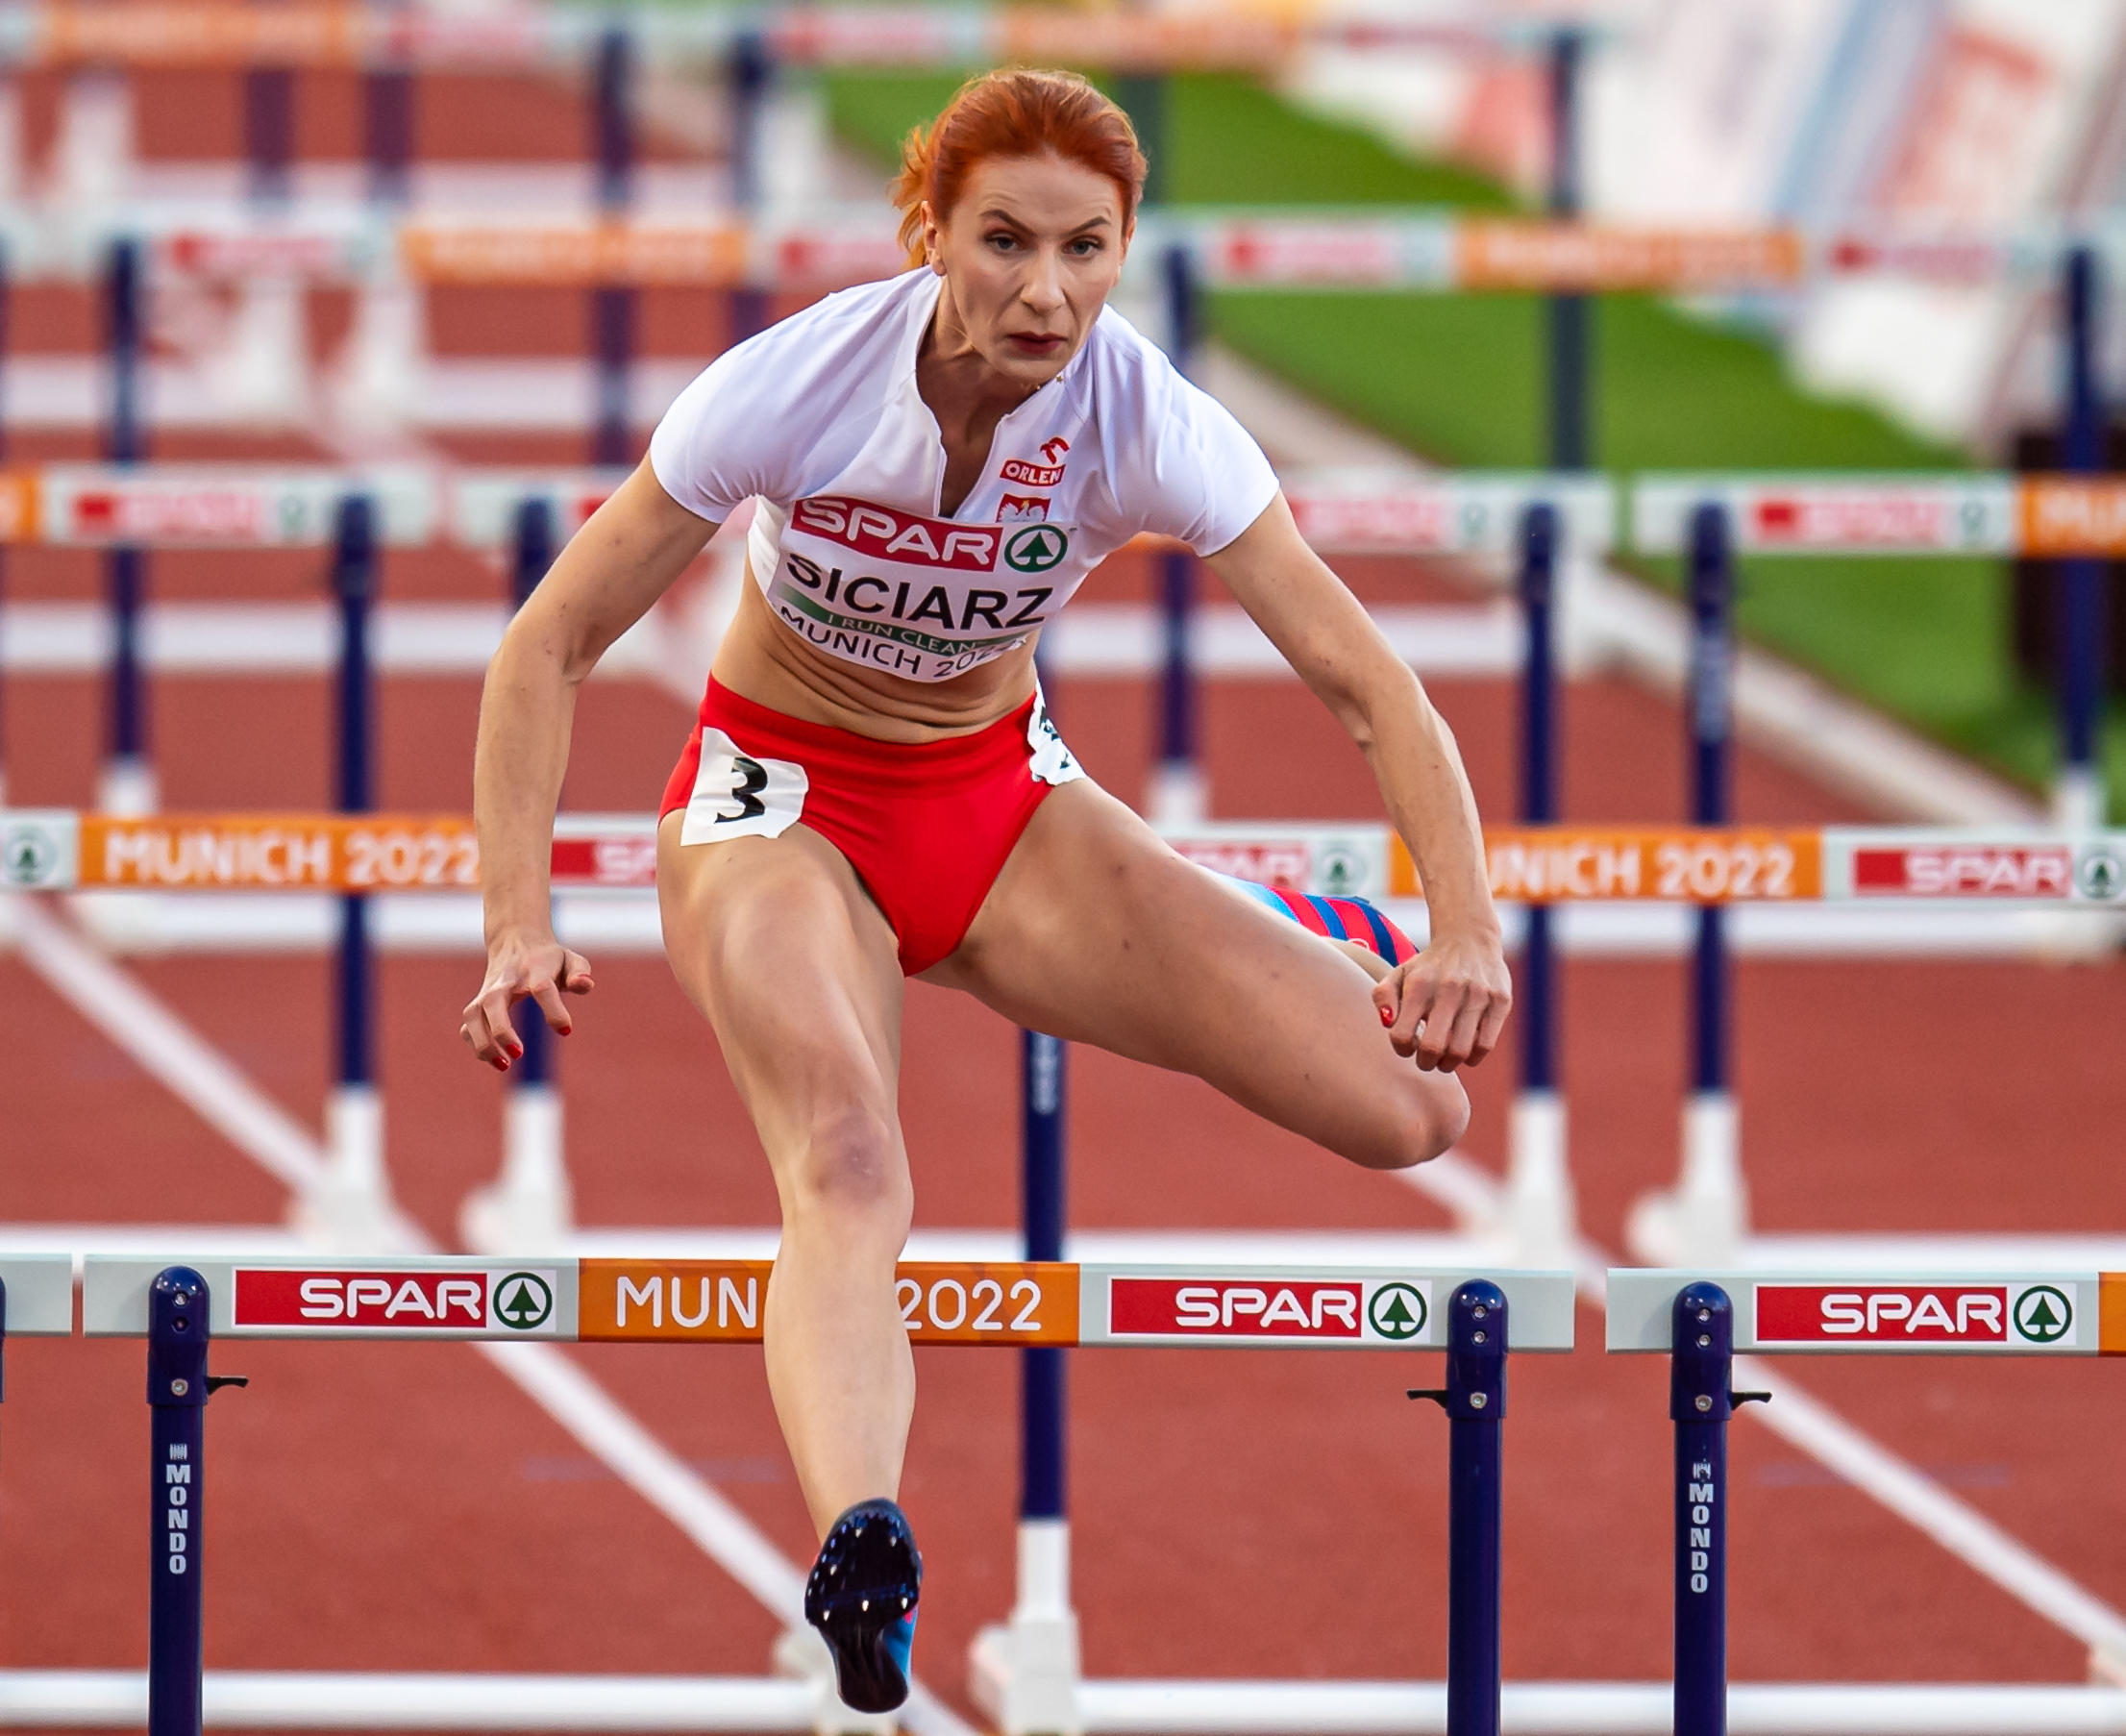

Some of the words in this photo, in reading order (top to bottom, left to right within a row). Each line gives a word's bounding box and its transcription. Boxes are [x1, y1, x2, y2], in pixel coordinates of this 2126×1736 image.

[1005, 462, 1062, 484] ORLEN
[799, 498, 995, 566] SPAR
[786, 552, 1054, 631] SICIARZ
[780, 606, 922, 676] MUNICH
[841, 618, 893, 637] RUN
[901, 630, 977, 655] CLEAN
[714, 756, 769, 824] 3
[105, 830, 333, 885] MUNICH
[345, 831, 481, 885] 2022
[1655, 843, 1794, 896] 2022
[1908, 854, 2065, 894] SPAR
[300, 1278, 482, 1320] SPAR
[615, 1276, 757, 1328] MUN
[895, 1277, 1042, 1331] 2022
[1174, 1287, 1357, 1329] SPAR
[1820, 1293, 2002, 1334] SPAR
[165, 1464, 191, 1575] MONDO
[1689, 1483, 1715, 1594] MONDO
